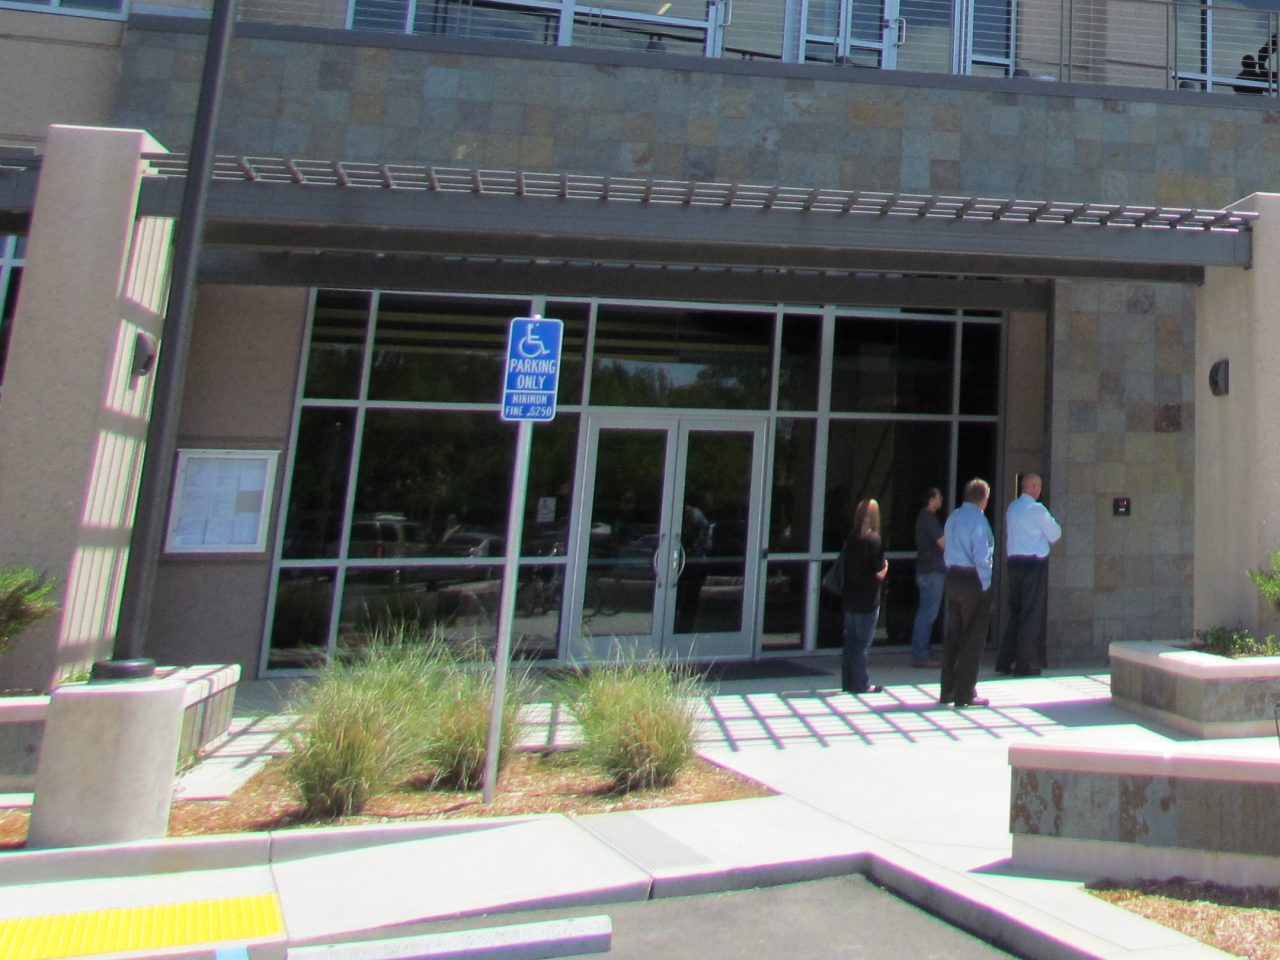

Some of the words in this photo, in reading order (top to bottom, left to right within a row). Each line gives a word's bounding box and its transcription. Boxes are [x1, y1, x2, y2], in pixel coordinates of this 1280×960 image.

[510, 359, 555, 373] PARKING
[517, 375, 545, 389] ONLY
[512, 394, 547, 404] MINIMUM
[505, 405, 523, 416] FINE
